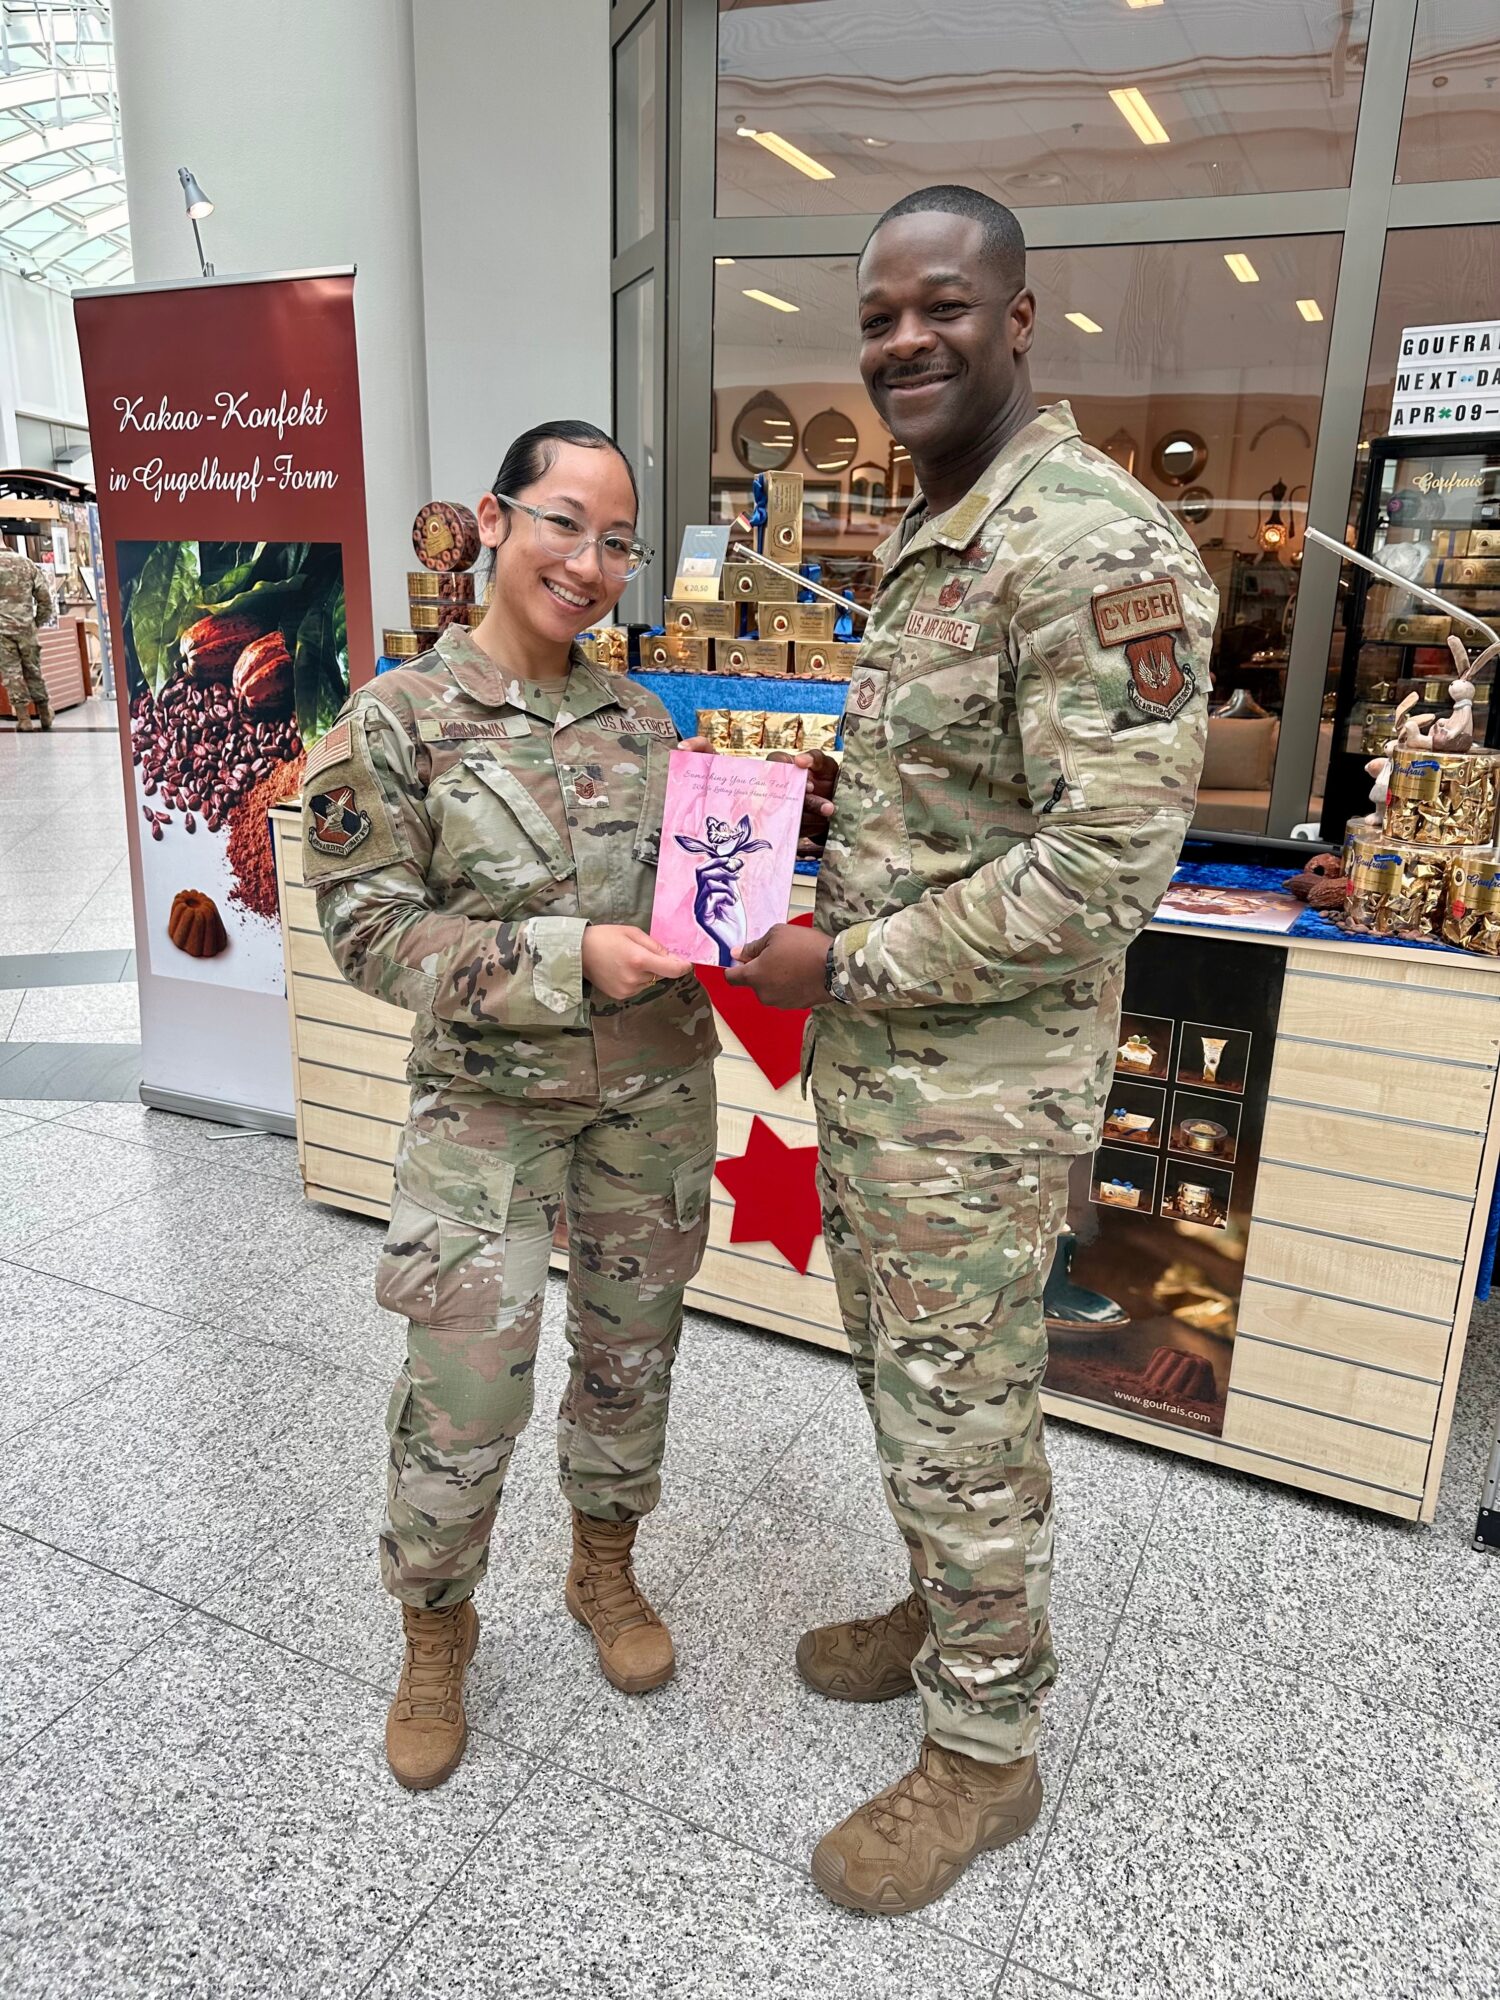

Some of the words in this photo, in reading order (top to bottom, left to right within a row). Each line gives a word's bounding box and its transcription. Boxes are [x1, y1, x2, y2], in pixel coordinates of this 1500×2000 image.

[1397, 371, 1457, 391] NEXT
[1393, 406, 1436, 426] APR
[109, 467, 131, 492] in
[1412, 471, 1486, 494] Goufrais
[1100, 591, 1177, 631] CYBER
[921, 617, 940, 639] AIR
[935, 619, 972, 646] FORCE
[619, 718, 640, 733] AIR
[638, 719, 675, 736] FORCE
[729, 775, 746, 786] You
[749, 777, 767, 786] Can
[1113, 1390, 1211, 1423] www.goufrais.com
